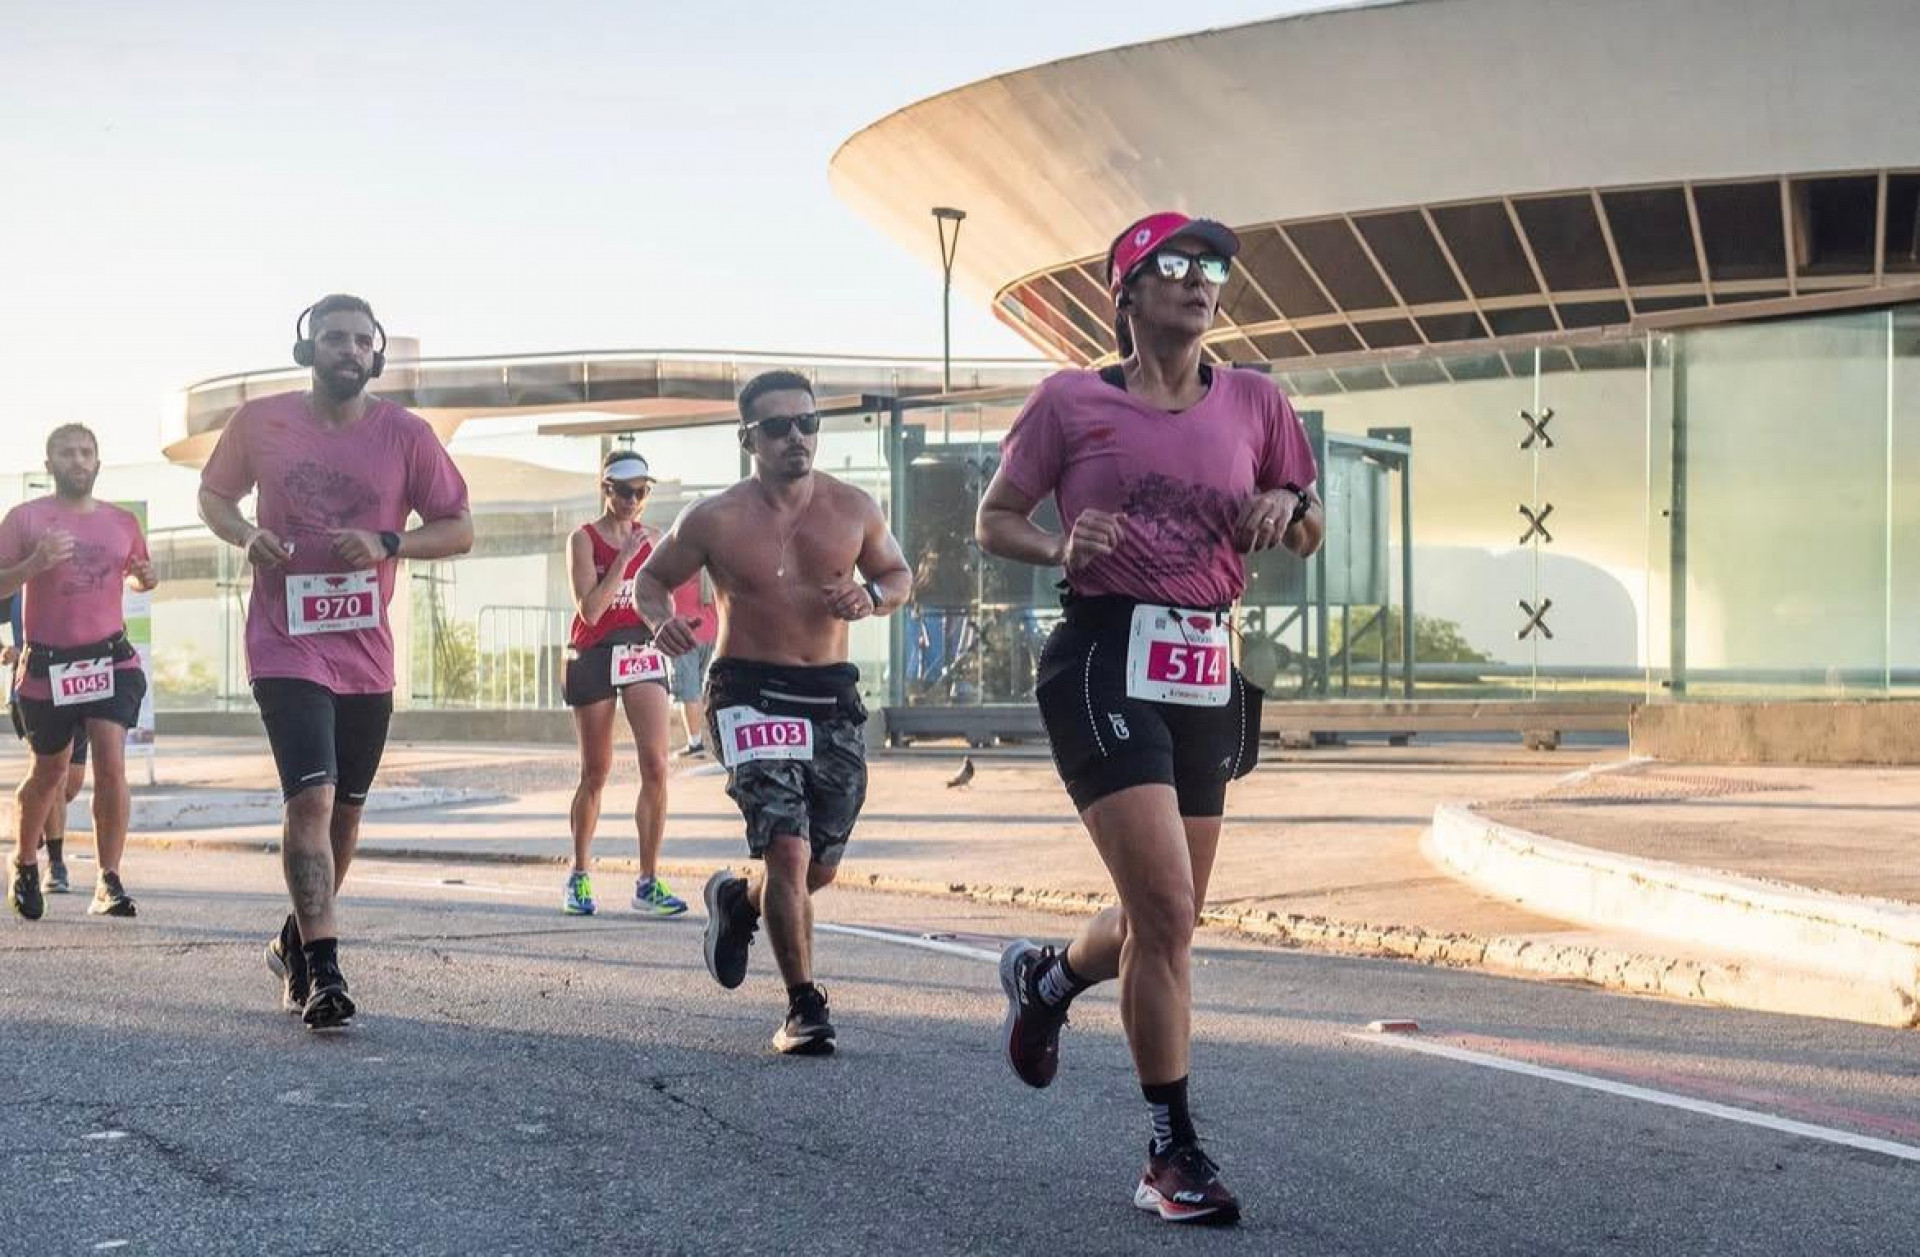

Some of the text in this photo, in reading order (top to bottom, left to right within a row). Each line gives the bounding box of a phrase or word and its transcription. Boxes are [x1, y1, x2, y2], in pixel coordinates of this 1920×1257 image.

[315, 596, 361, 620] 970
[626, 656, 652, 674] 463
[1166, 647, 1220, 683] 514
[65, 673, 107, 695] 1045
[741, 723, 802, 747] 1103
